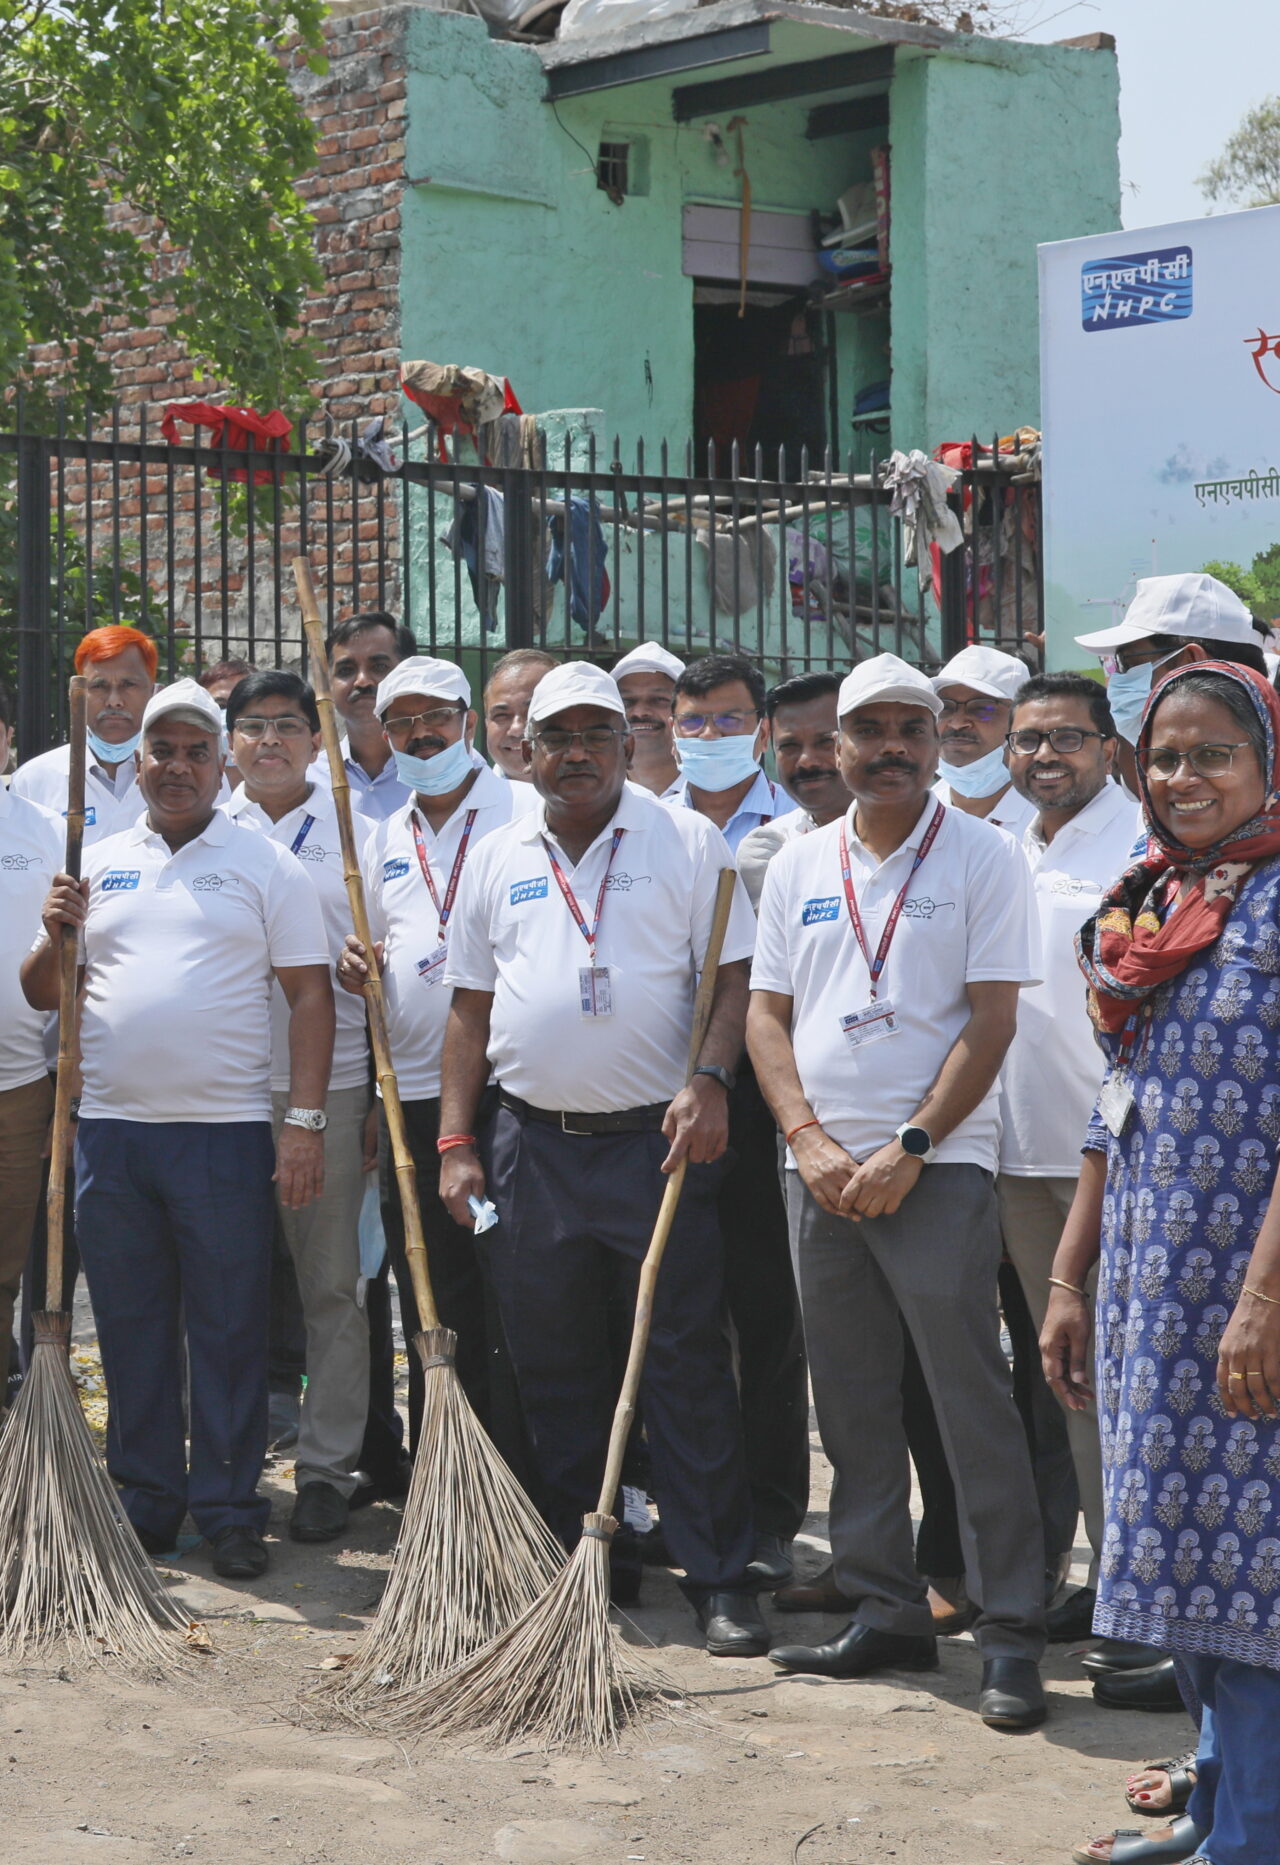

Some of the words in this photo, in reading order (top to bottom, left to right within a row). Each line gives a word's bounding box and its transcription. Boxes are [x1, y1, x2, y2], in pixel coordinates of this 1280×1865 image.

[1092, 291, 1176, 322] NHPC
[1194, 466, 1280, 508] एनएचपीसी
[105, 880, 133, 889] NHPC
[807, 912, 832, 923] NHPC
